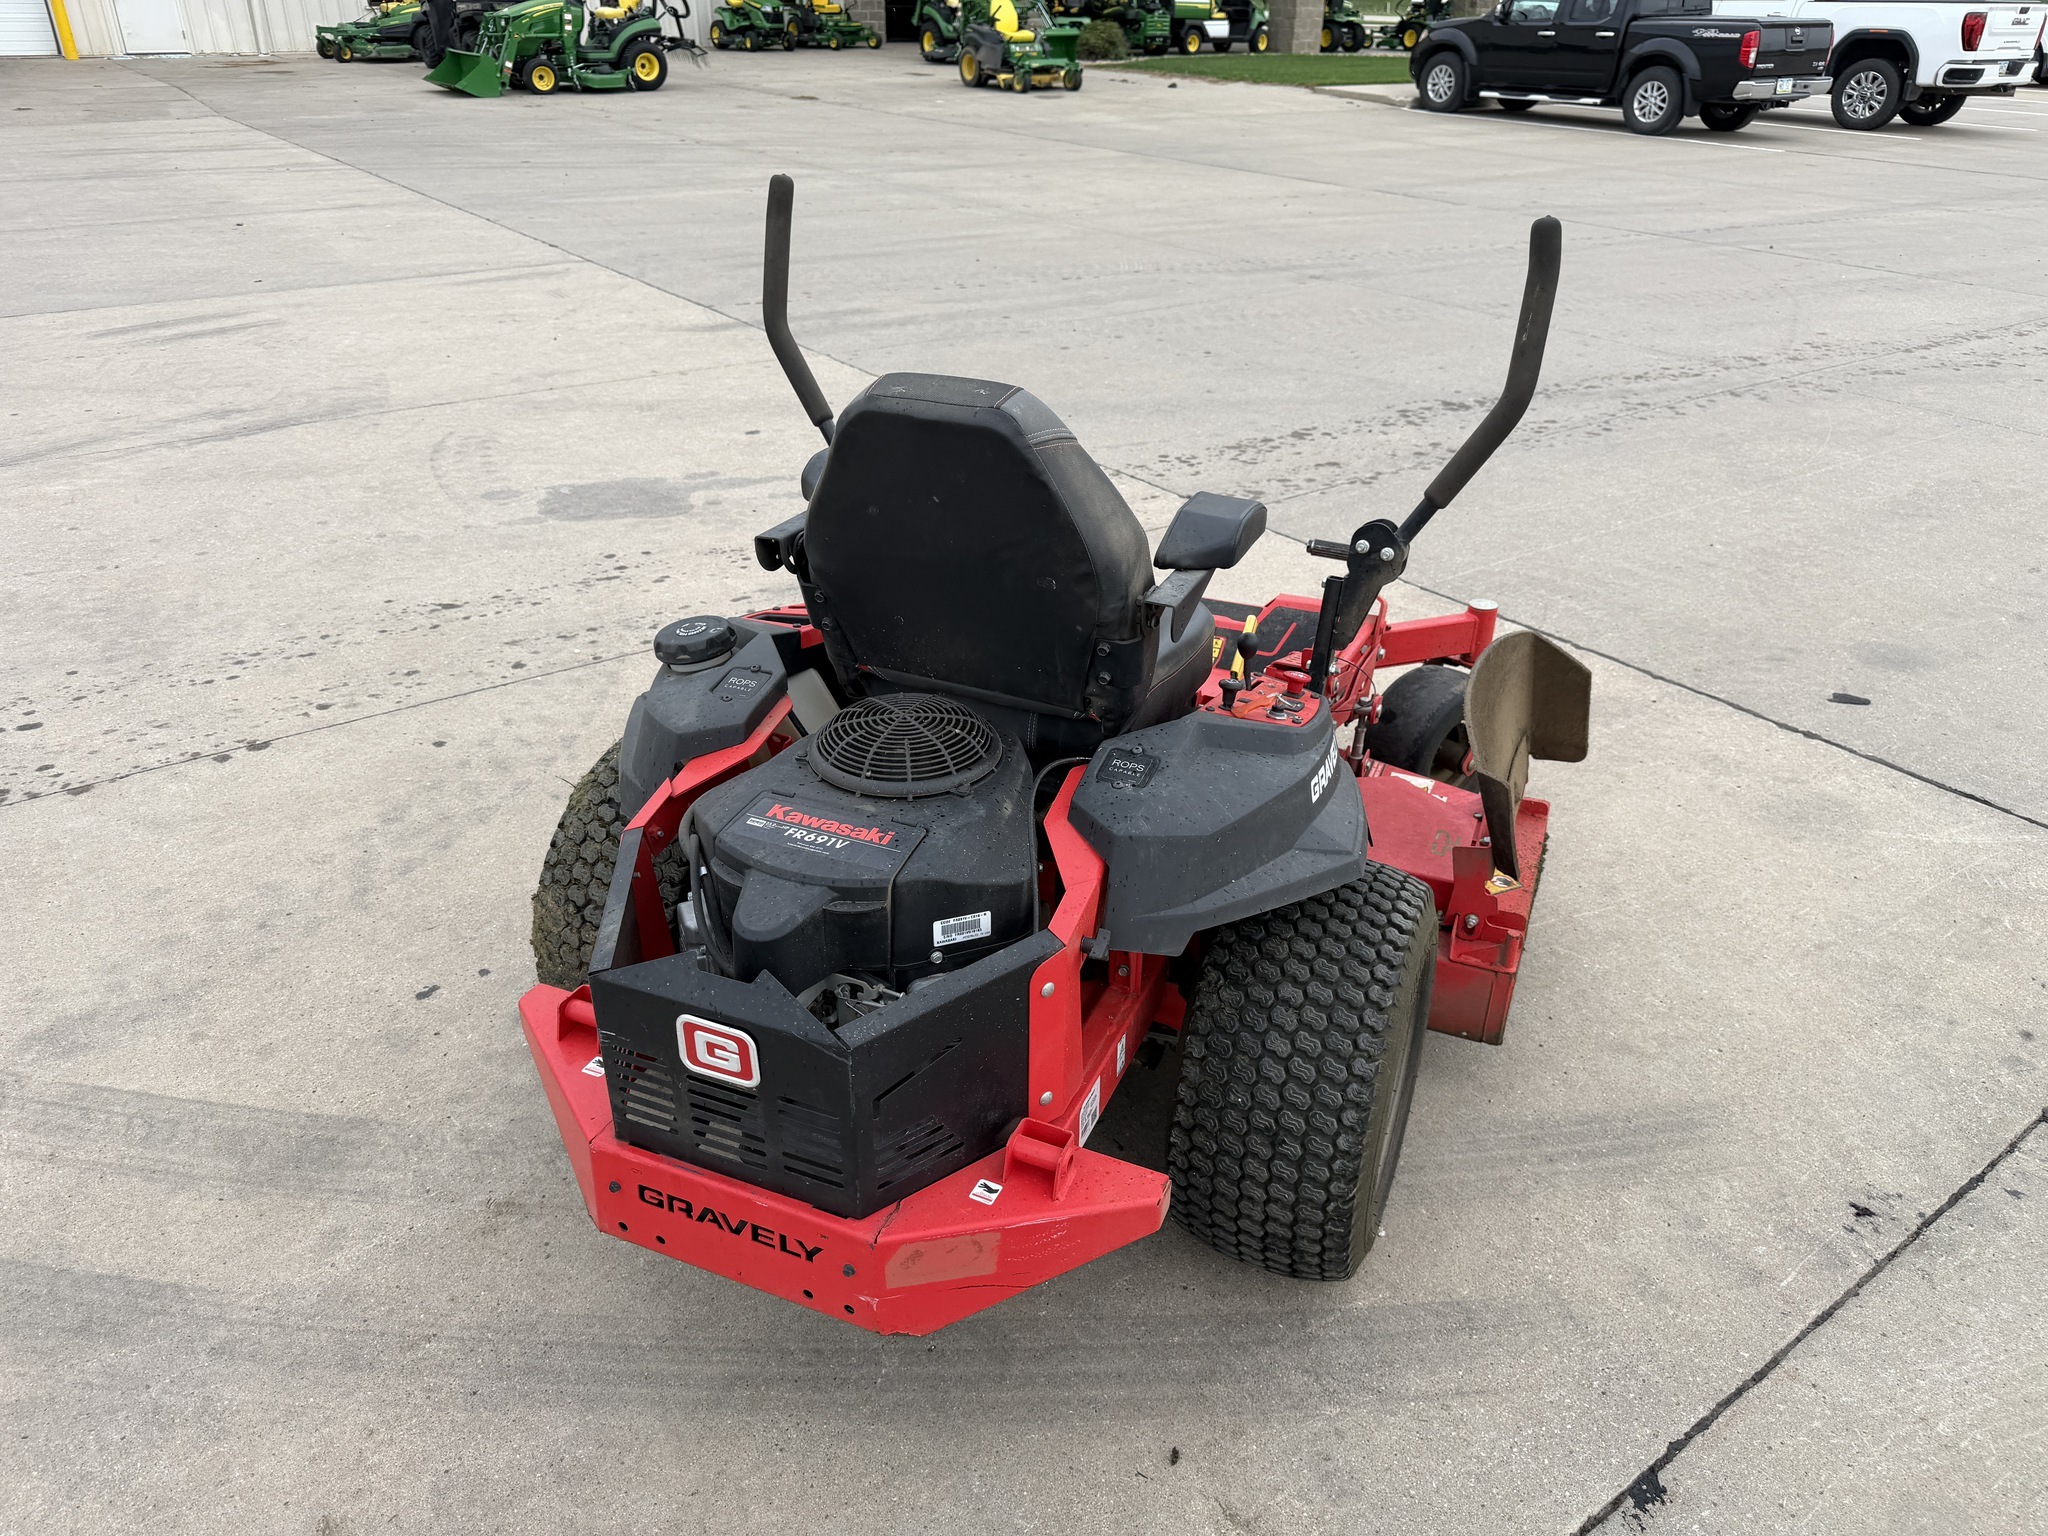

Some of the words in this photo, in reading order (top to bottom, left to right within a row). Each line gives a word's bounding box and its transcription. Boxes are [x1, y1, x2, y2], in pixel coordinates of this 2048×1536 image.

[2011, 17, 2030, 26] GMC
[728, 676, 758, 688] ROPS
[1111, 758, 1146, 772] ROPS
[765, 803, 896, 845] Kawasaki
[783, 827, 851, 849] FR691V
[637, 1183, 825, 1264] GRAVELY
